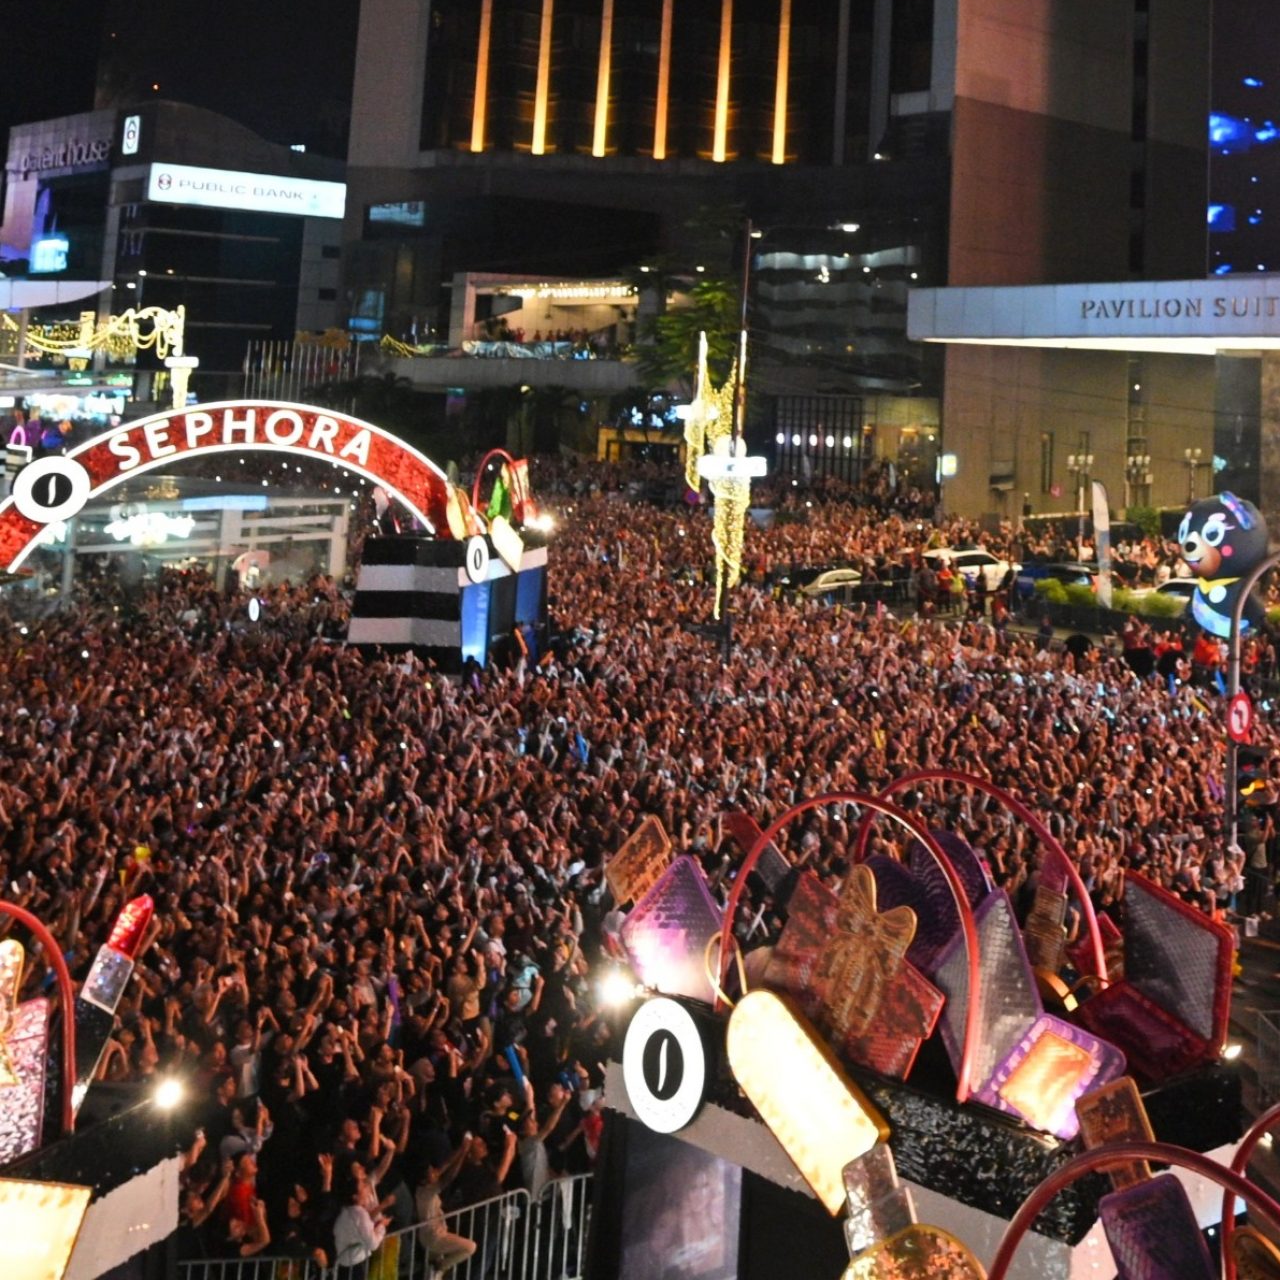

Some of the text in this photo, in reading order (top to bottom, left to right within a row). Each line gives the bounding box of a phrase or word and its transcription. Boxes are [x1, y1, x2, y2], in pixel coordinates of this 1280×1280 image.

[179, 178, 246, 196] PUBLIC
[252, 186, 305, 201] BANK
[1081, 299, 1202, 320] PAVILION
[108, 407, 373, 471] SEPHORA
